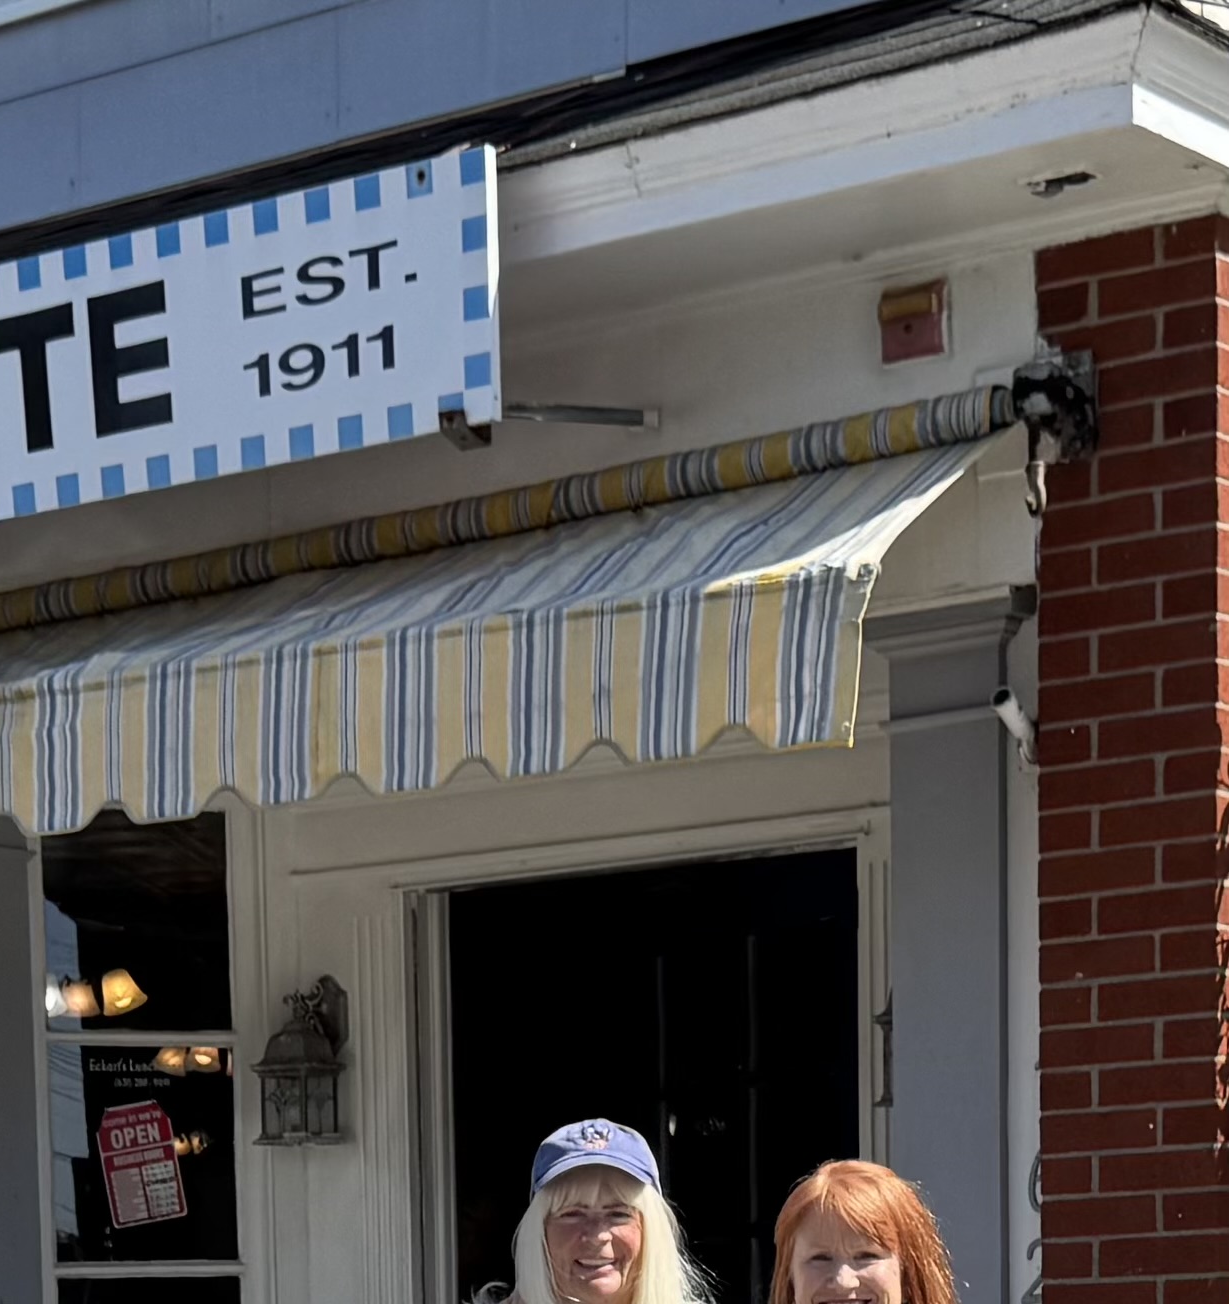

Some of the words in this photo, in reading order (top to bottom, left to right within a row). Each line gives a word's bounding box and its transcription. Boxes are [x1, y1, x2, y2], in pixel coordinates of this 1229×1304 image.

[240, 240, 418, 320] EST.
[244, 325, 396, 398] 1911
[110, 1121, 160, 1149] OPEN
